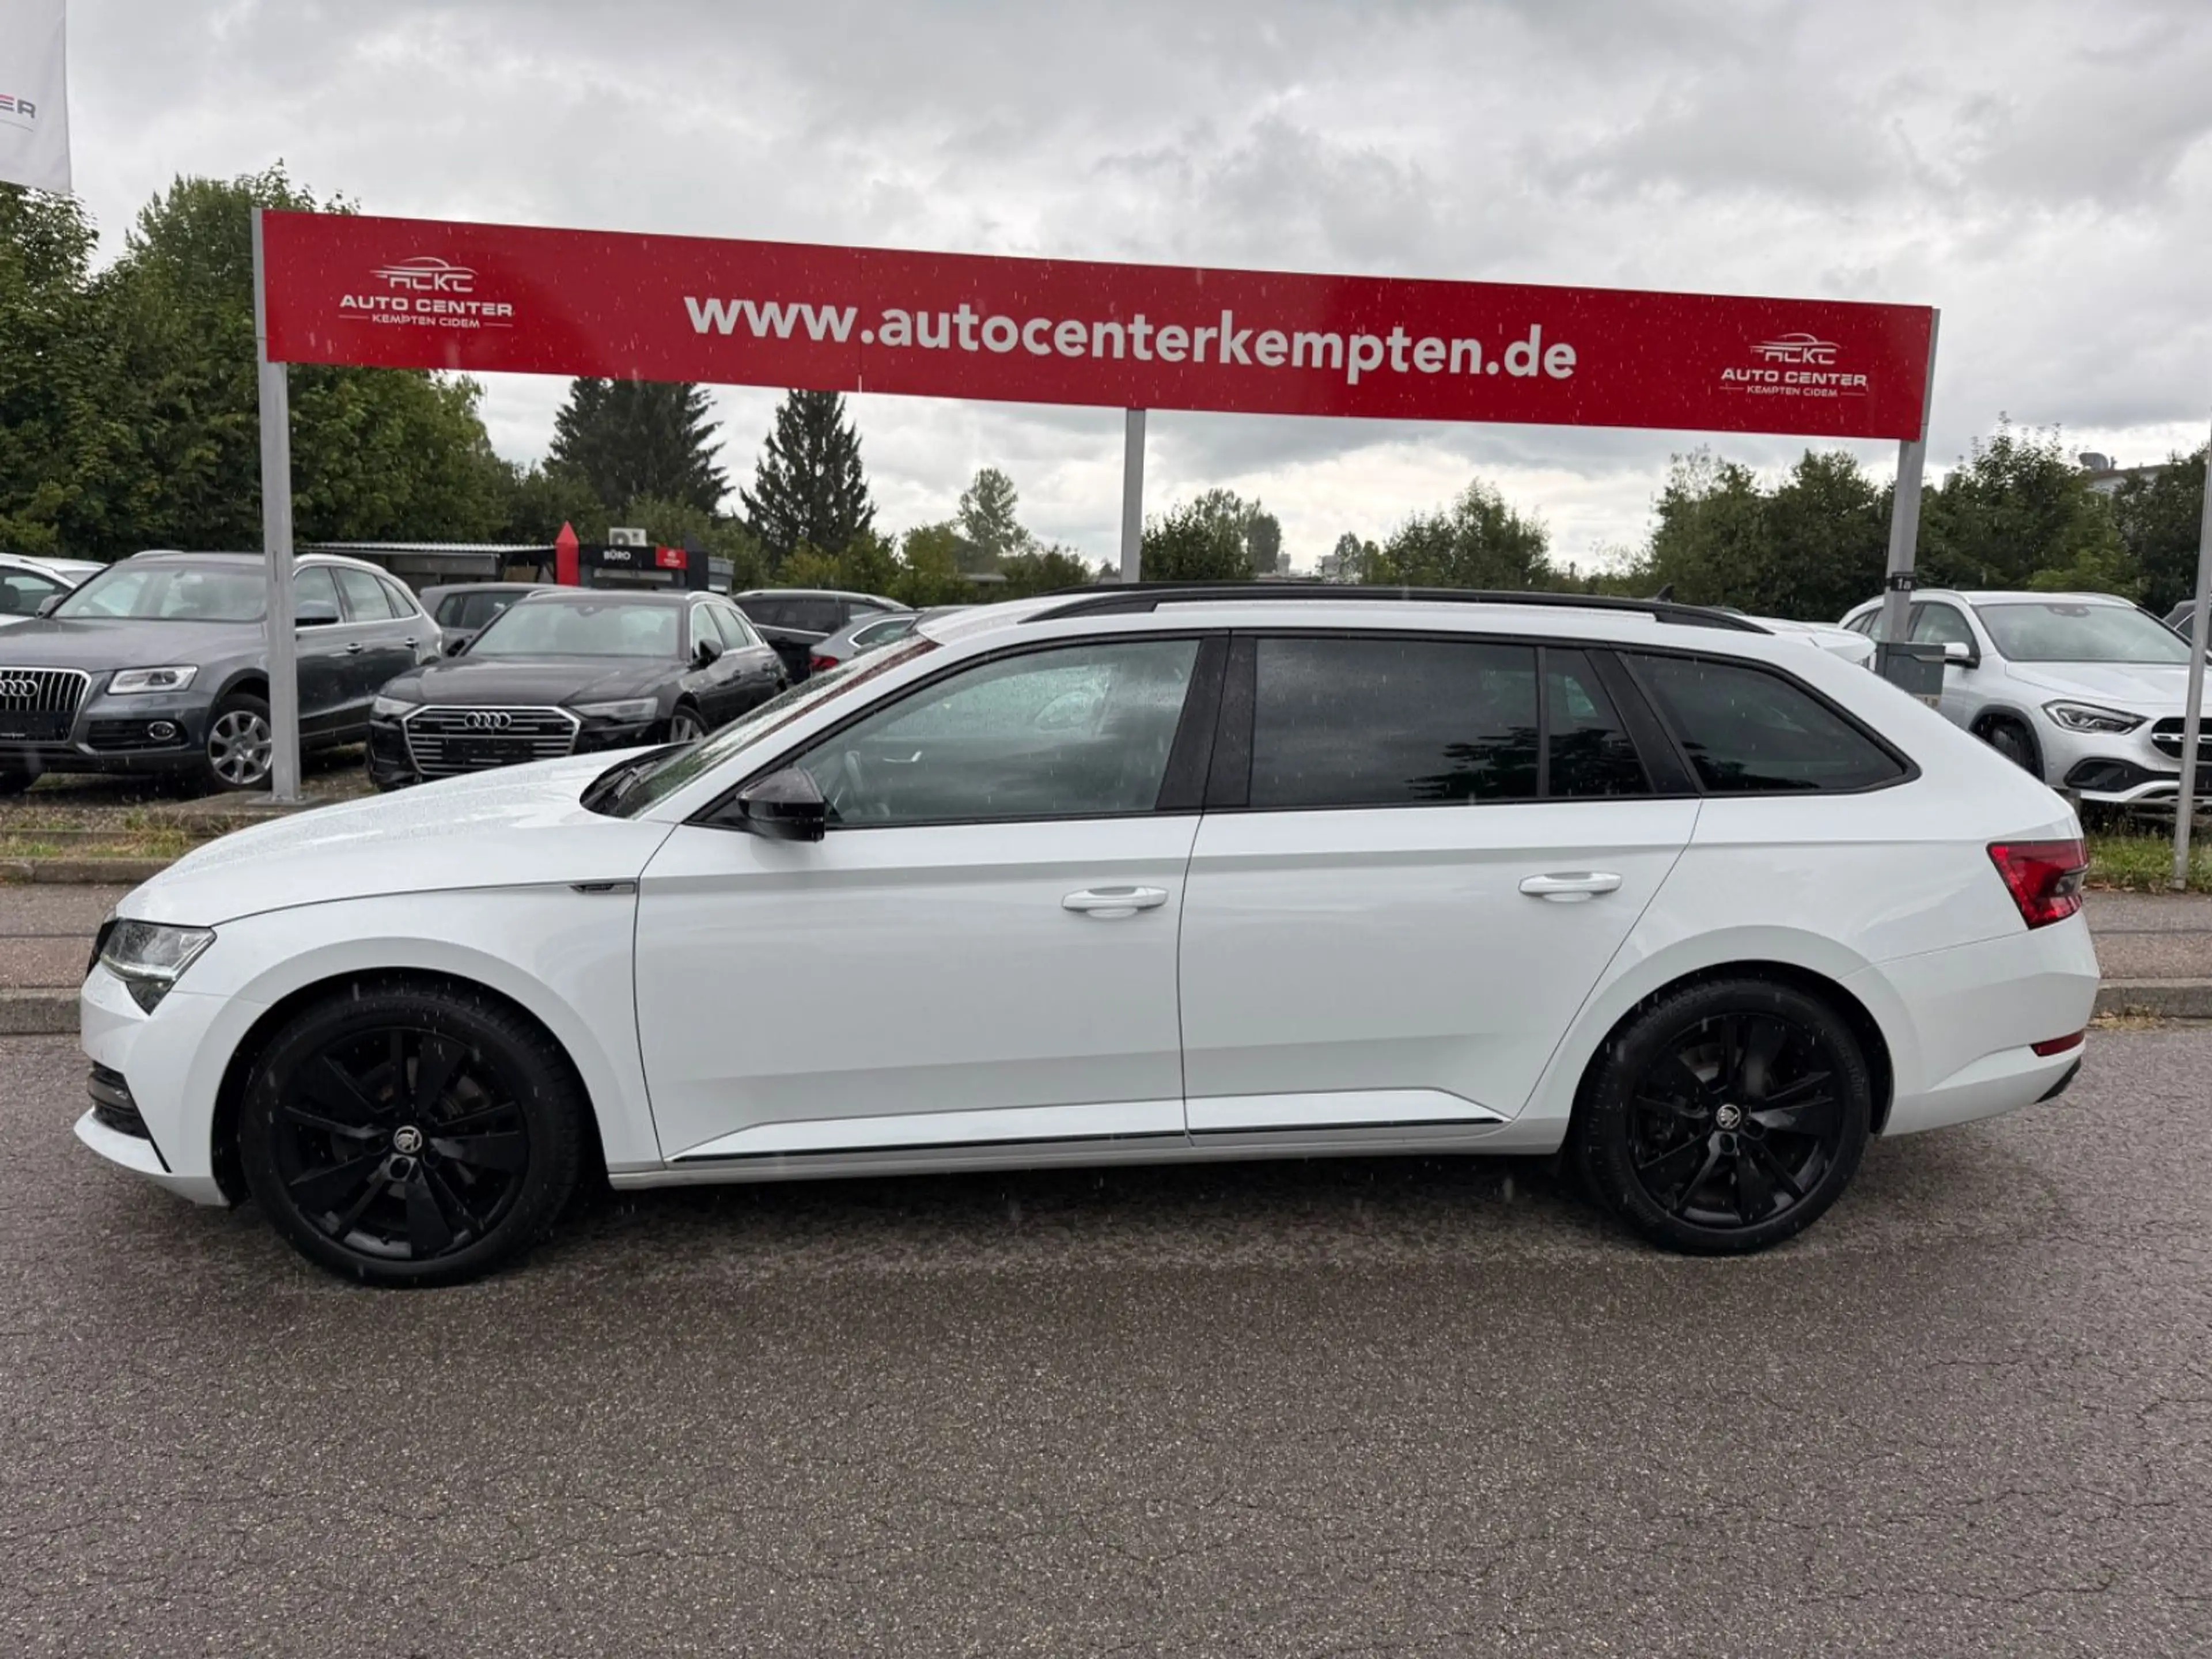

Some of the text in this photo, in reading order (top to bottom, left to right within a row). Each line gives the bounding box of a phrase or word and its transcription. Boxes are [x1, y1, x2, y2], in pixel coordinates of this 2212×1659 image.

[340, 294, 513, 317] AUTO CENTER
[372, 313, 480, 328] KEMPTEN CIDEM
[684, 297, 1577, 384] www.autocenterkempten.de
[1721, 368, 1868, 387] AUTO CENTER
[1747, 385, 1838, 397] KEMPTEN CIDEM
[604, 548, 631, 561] BÜRO
